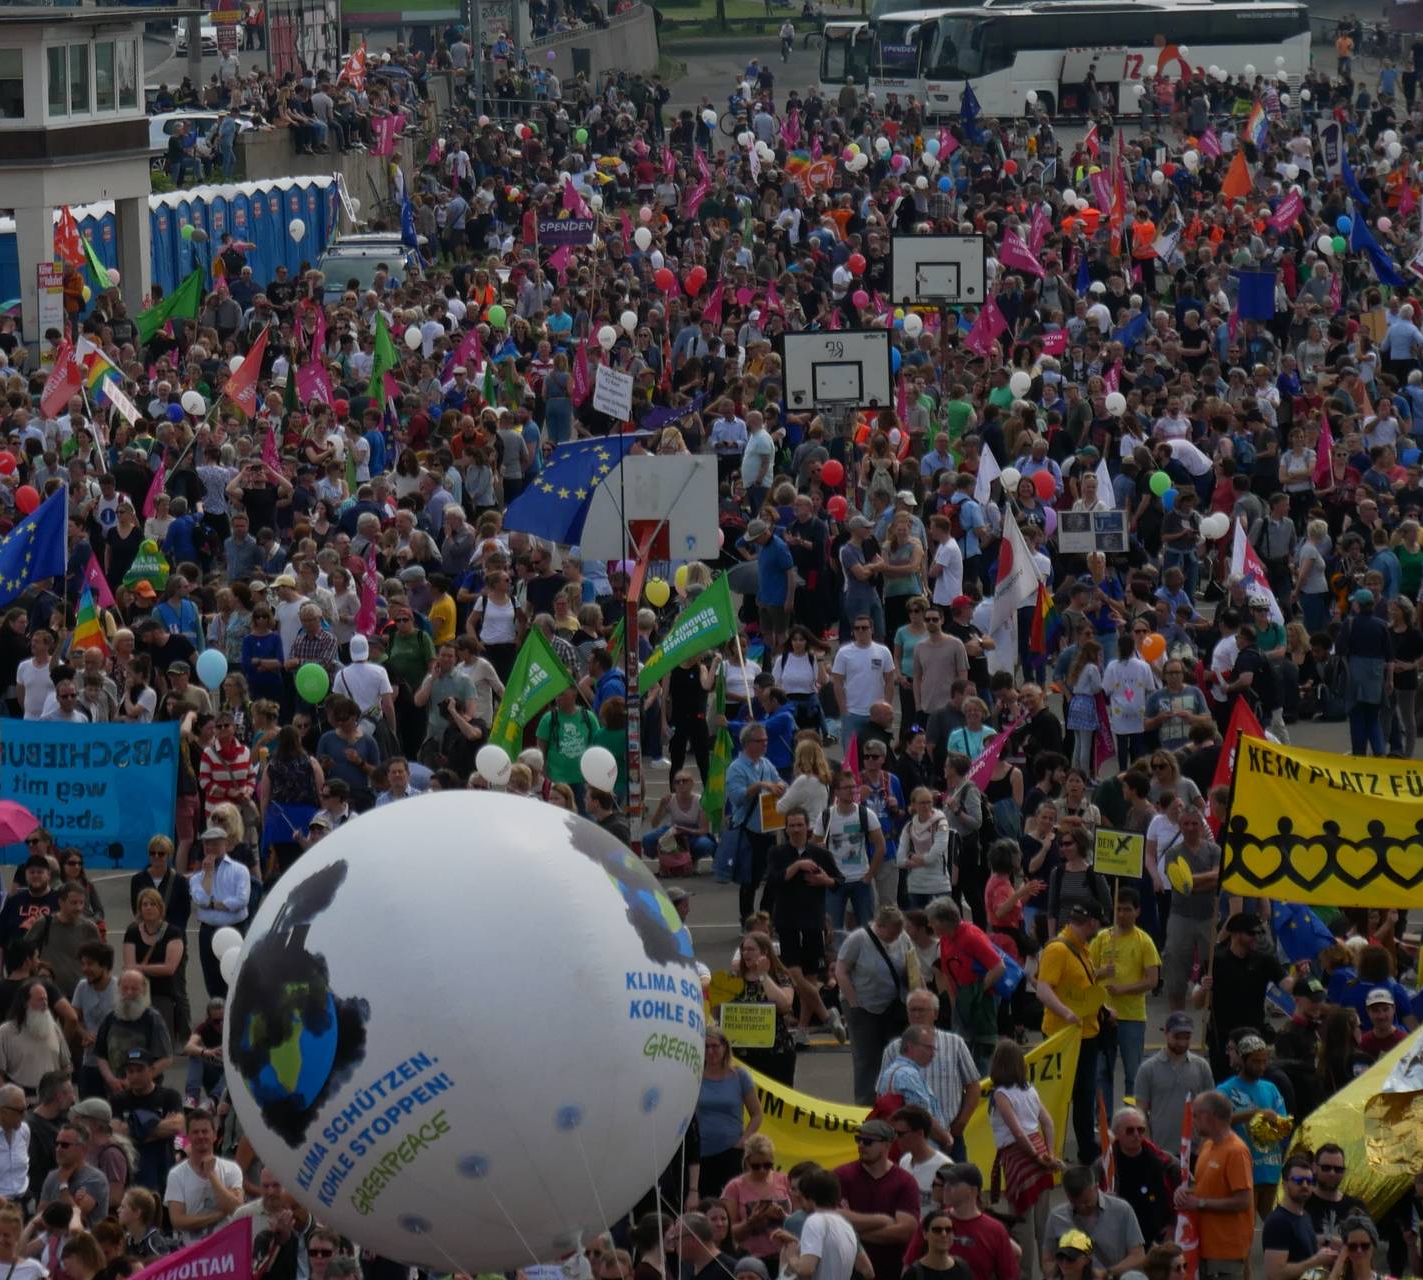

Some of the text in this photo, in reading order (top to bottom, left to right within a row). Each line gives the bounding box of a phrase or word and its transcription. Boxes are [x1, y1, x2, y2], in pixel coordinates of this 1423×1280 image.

[540, 220, 594, 234] SPENDEN
[1248, 744, 1302, 782] KEIN
[1308, 763, 1384, 797] PLATZ
[625, 971, 677, 994] KLIMA
[629, 999, 685, 1024] KOHLE
[296, 1051, 439, 1192] KLIMA SCHÜTZEN.
[317, 1071, 455, 1208] KOHLE STOPPEN!
[792, 1105, 865, 1134] FLÜC
[350, 1109, 451, 1216] GREENPEACE
